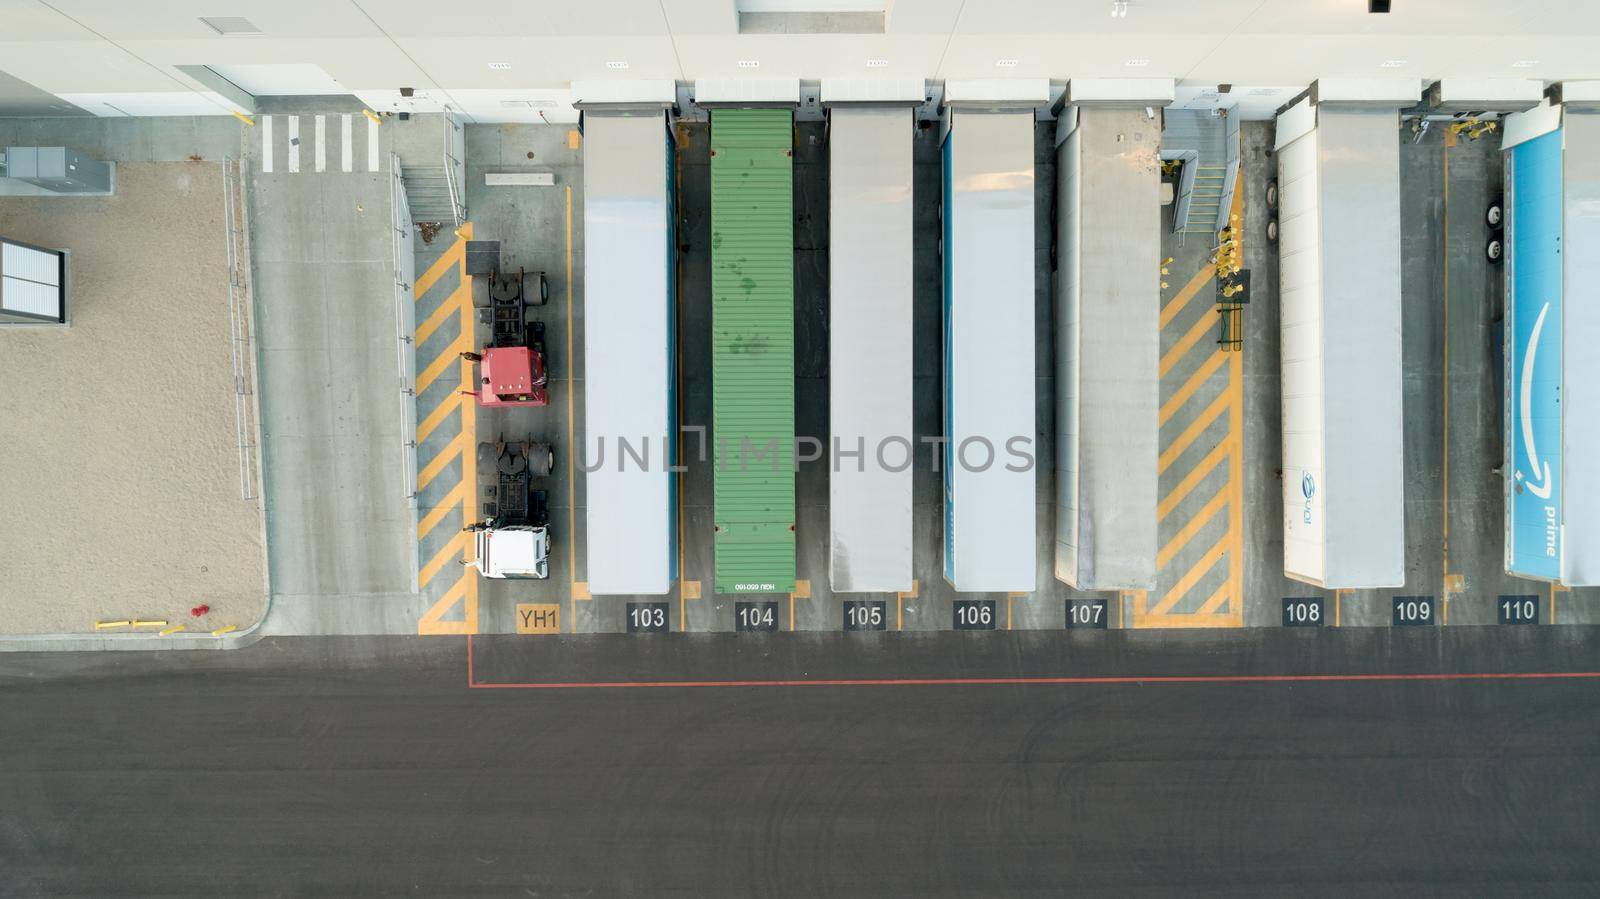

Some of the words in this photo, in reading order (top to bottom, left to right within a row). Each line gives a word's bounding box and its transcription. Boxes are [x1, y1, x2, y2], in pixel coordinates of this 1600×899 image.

[1544, 505, 1558, 557] prime
[520, 609, 556, 628] YH1
[631, 608, 665, 627] 103
[740, 607, 774, 626] 104
[848, 606, 882, 625] 105
[957, 606, 991, 625] 106
[1070, 604, 1103, 624] 107
[1286, 602, 1320, 622] 108
[1396, 601, 1430, 621] 109
[1502, 600, 1534, 619] 110
